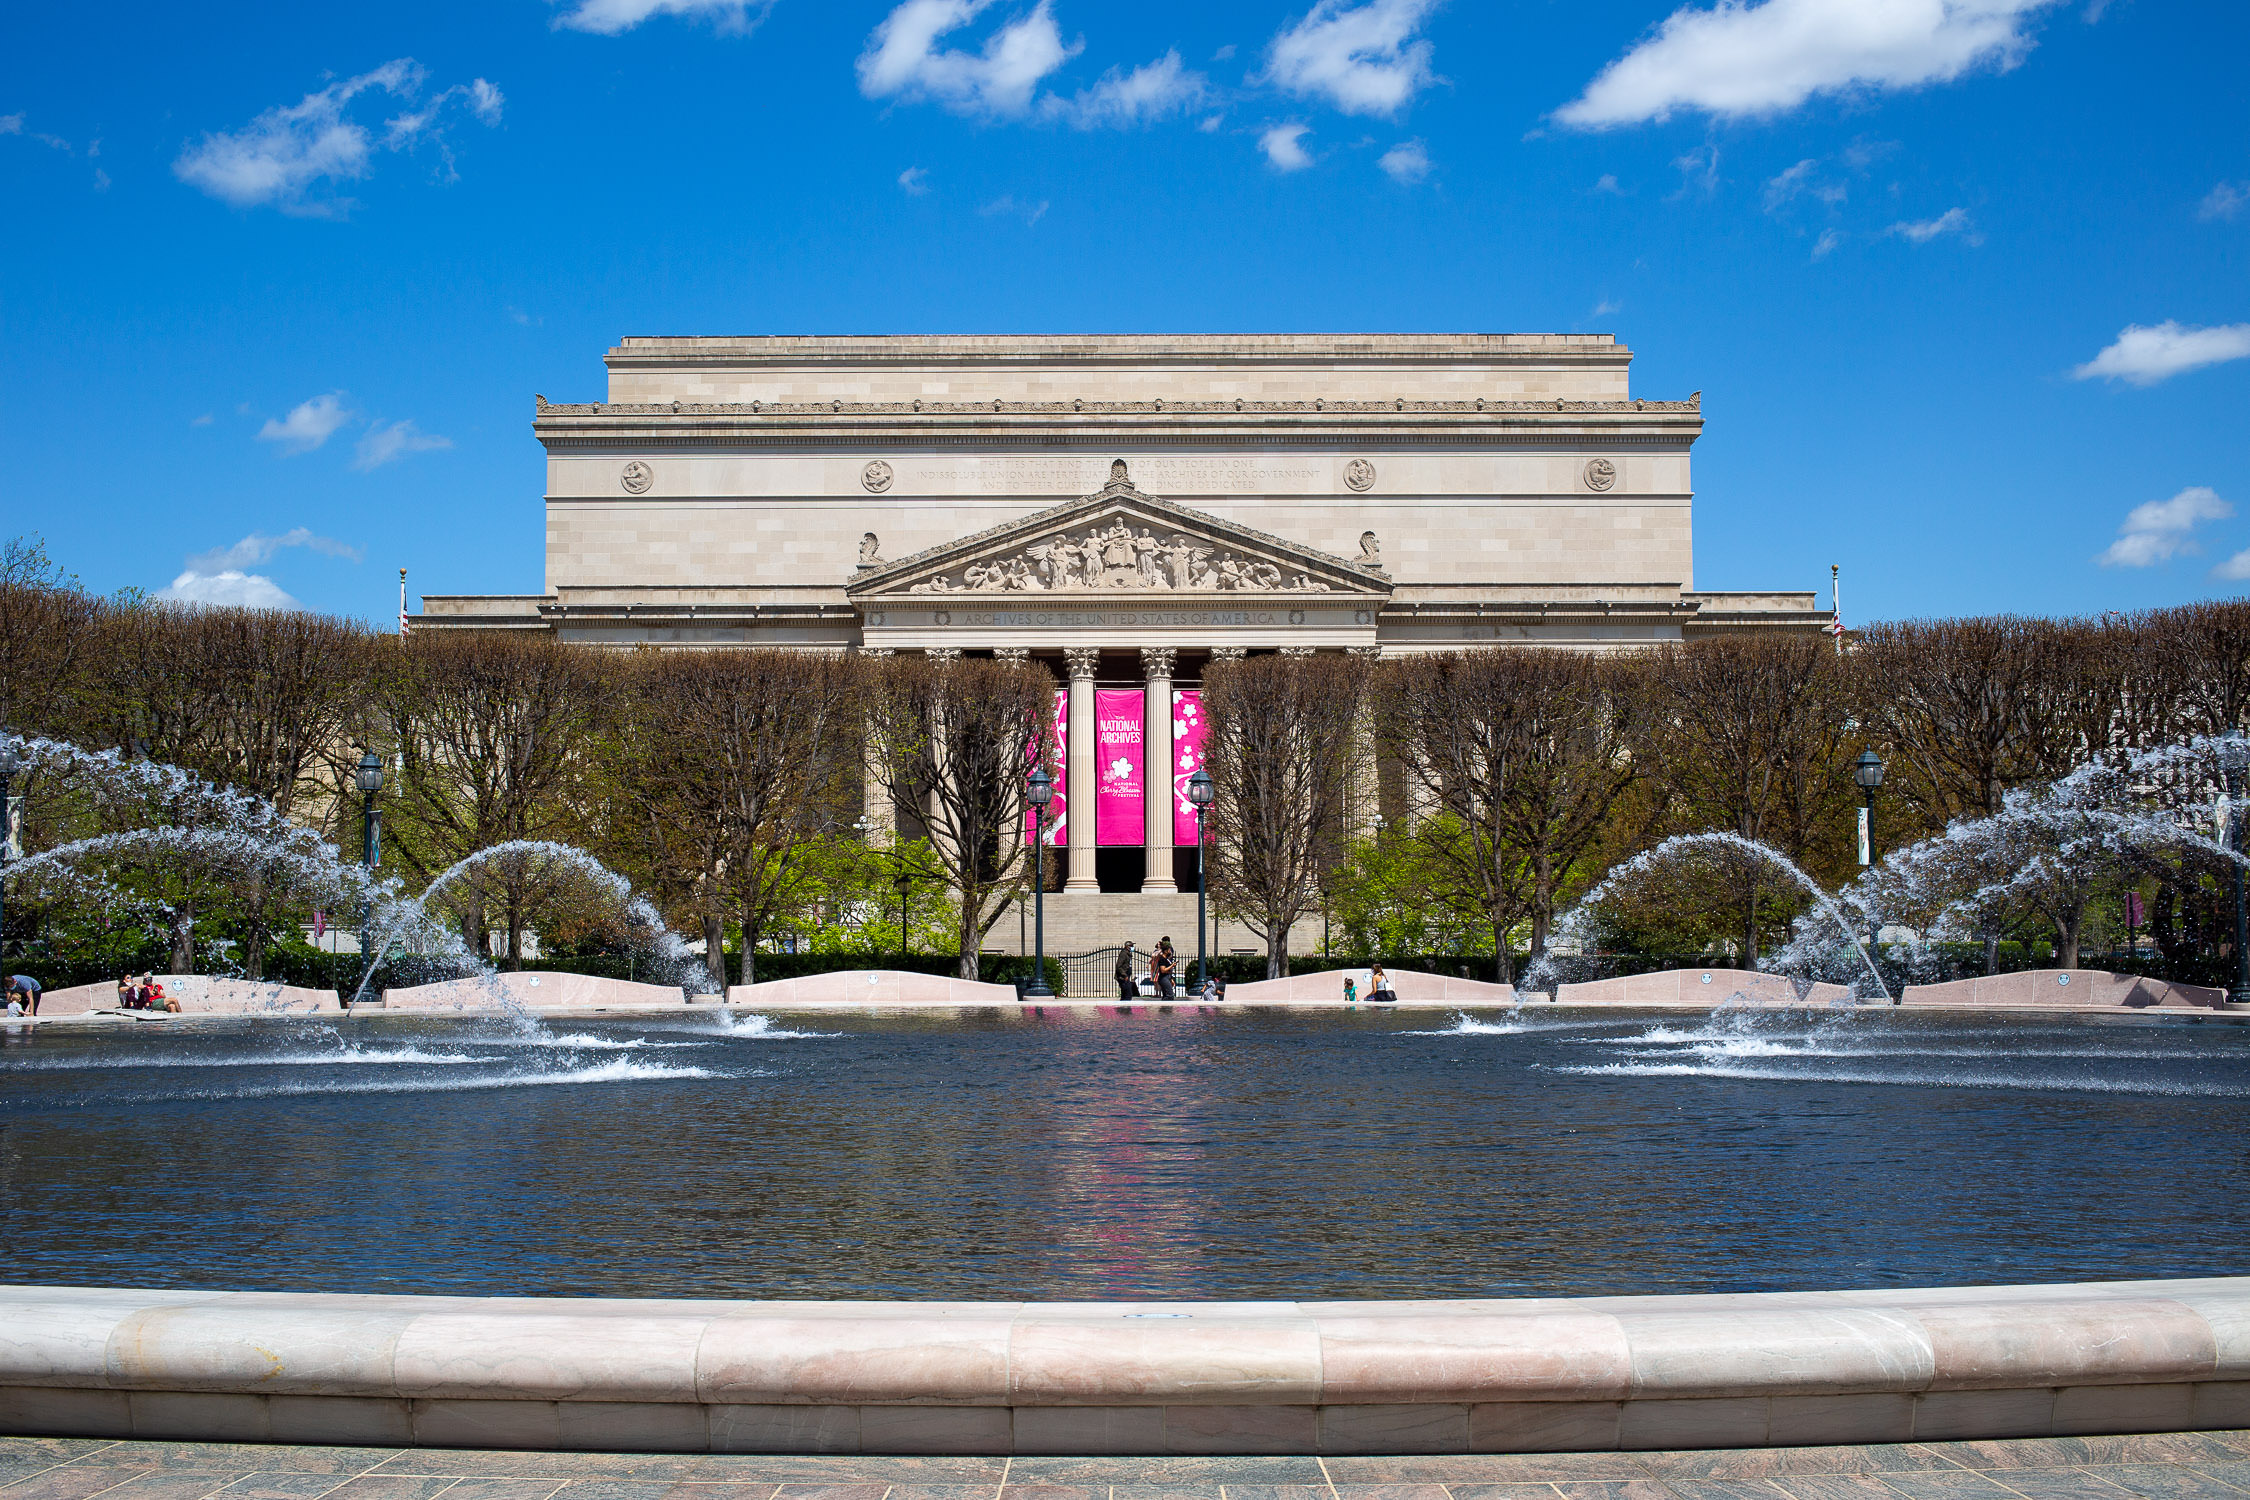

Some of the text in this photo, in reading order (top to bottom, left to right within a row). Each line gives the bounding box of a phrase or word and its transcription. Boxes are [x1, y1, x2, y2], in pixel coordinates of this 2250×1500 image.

[982, 460, 1001, 469] THE
[1028, 460, 1055, 469] THAT
[1085, 460, 1105, 469] THE
[1154, 459, 1176, 468] OUR
[1232, 459, 1254, 468] ONE
[916, 471, 987, 480] INDISSOLUBLE
[991, 471, 1024, 480] UNION
[1029, 471, 1046, 480] ARE
[1158, 470, 1207, 479] ARCHIVES
[1227, 470, 1249, 479] OUR
[1252, 470, 1320, 479] GOVERNMENT
[982, 481, 1003, 490] AND
[1198, 480, 1255, 489] DEDICATED
[964, 613, 1275, 625] ARCHIVES OF THE UNITED STATES OF AMERICA
[1100, 720, 1140, 731] NATIONAL
[1100, 732, 1140, 743] ARCHIVES
